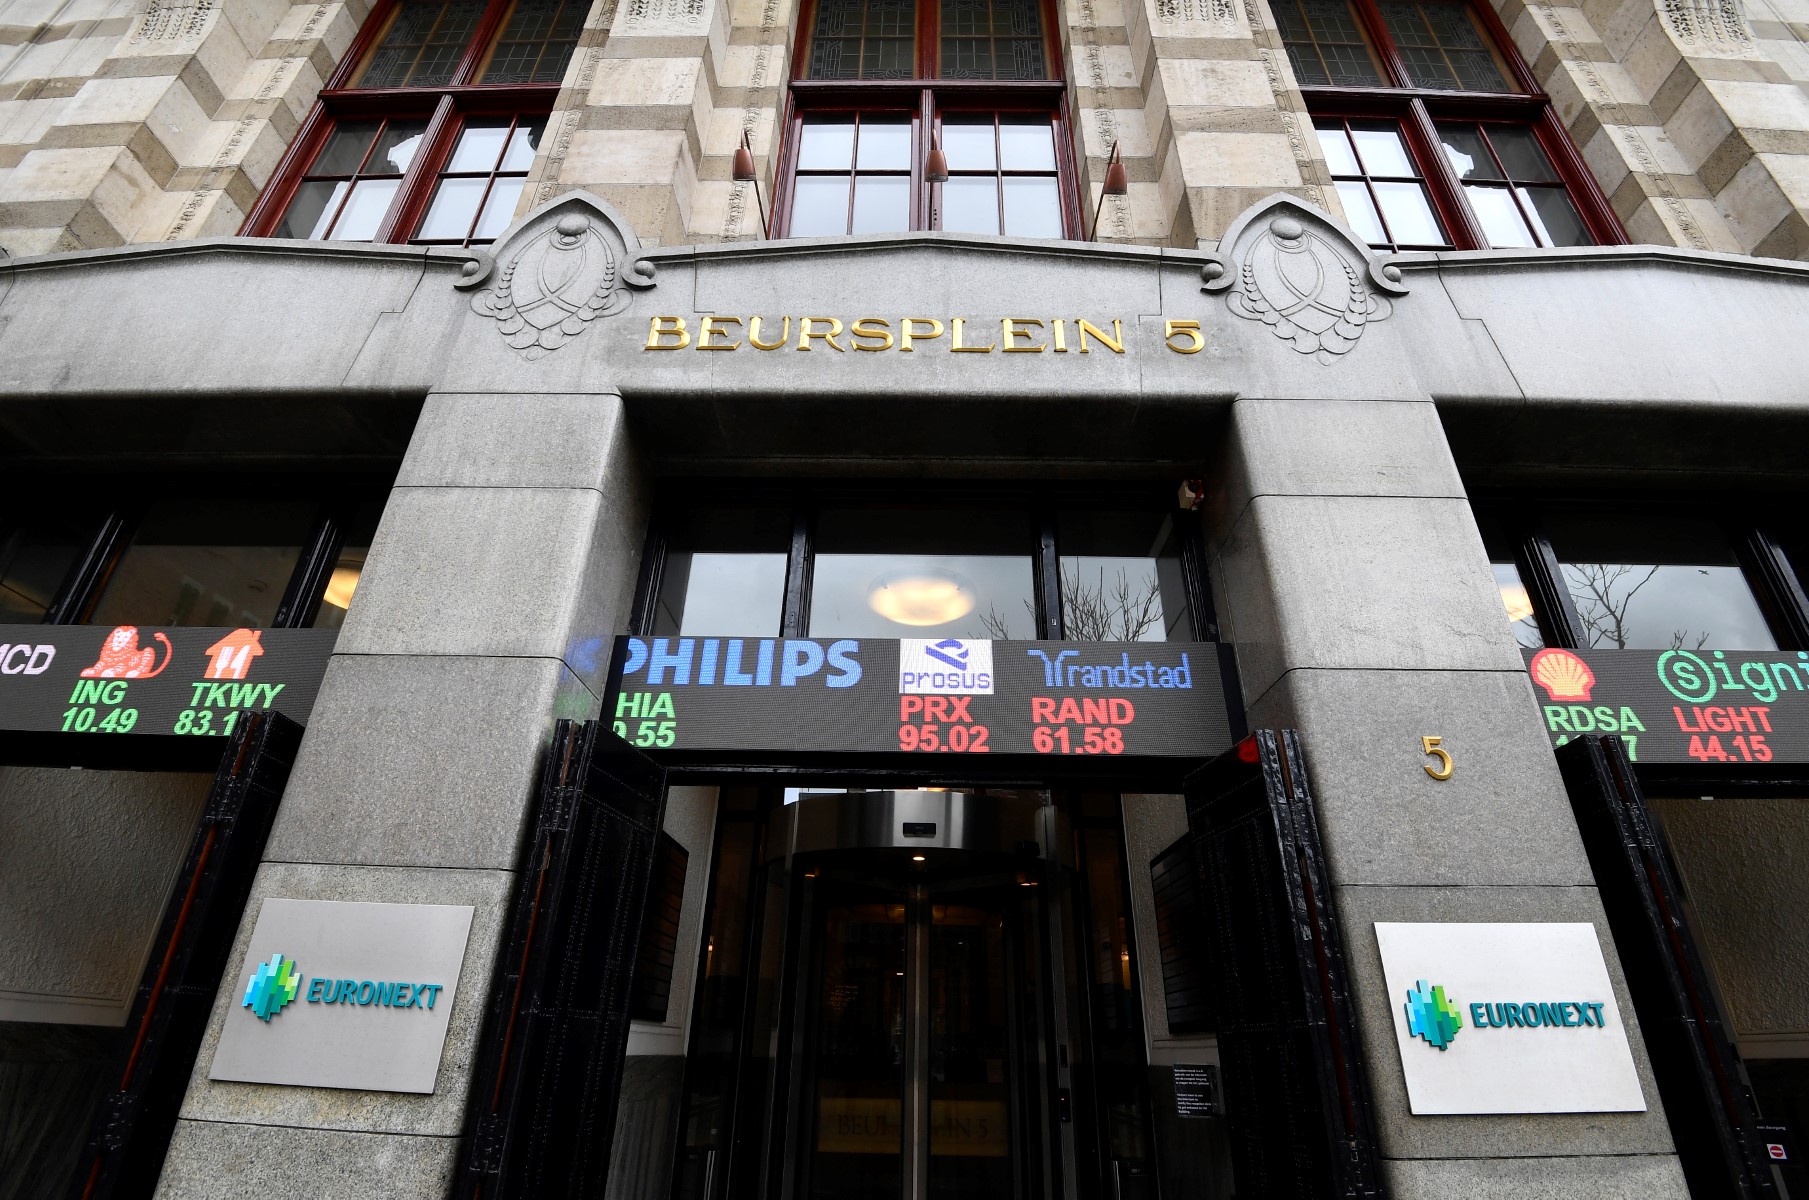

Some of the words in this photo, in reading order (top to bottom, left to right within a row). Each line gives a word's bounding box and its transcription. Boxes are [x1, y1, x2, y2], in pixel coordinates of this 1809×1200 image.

[644, 316, 1125, 354] BEURSPLEIN
[1165, 319, 1205, 354] 5
[69, 680, 128, 705] ING
[190, 682, 285, 708] TKWY
[902, 671, 990, 693] prosus
[61, 707, 139, 734] 10.49
[900, 696, 973, 723] PRX
[1031, 697, 1135, 724] RAND
[1544, 706, 1647, 732] RDSA
[1673, 706, 1773, 732] LIGHT
[899, 724, 990, 753] 95.02
[1032, 726, 1125, 755] 61.58
[1688, 735, 1773, 762] 44.15
[1422, 735, 1455, 781] 5
[306, 978, 442, 1009] EURONEXT
[1470, 1001, 1605, 1028] EURONEXT
